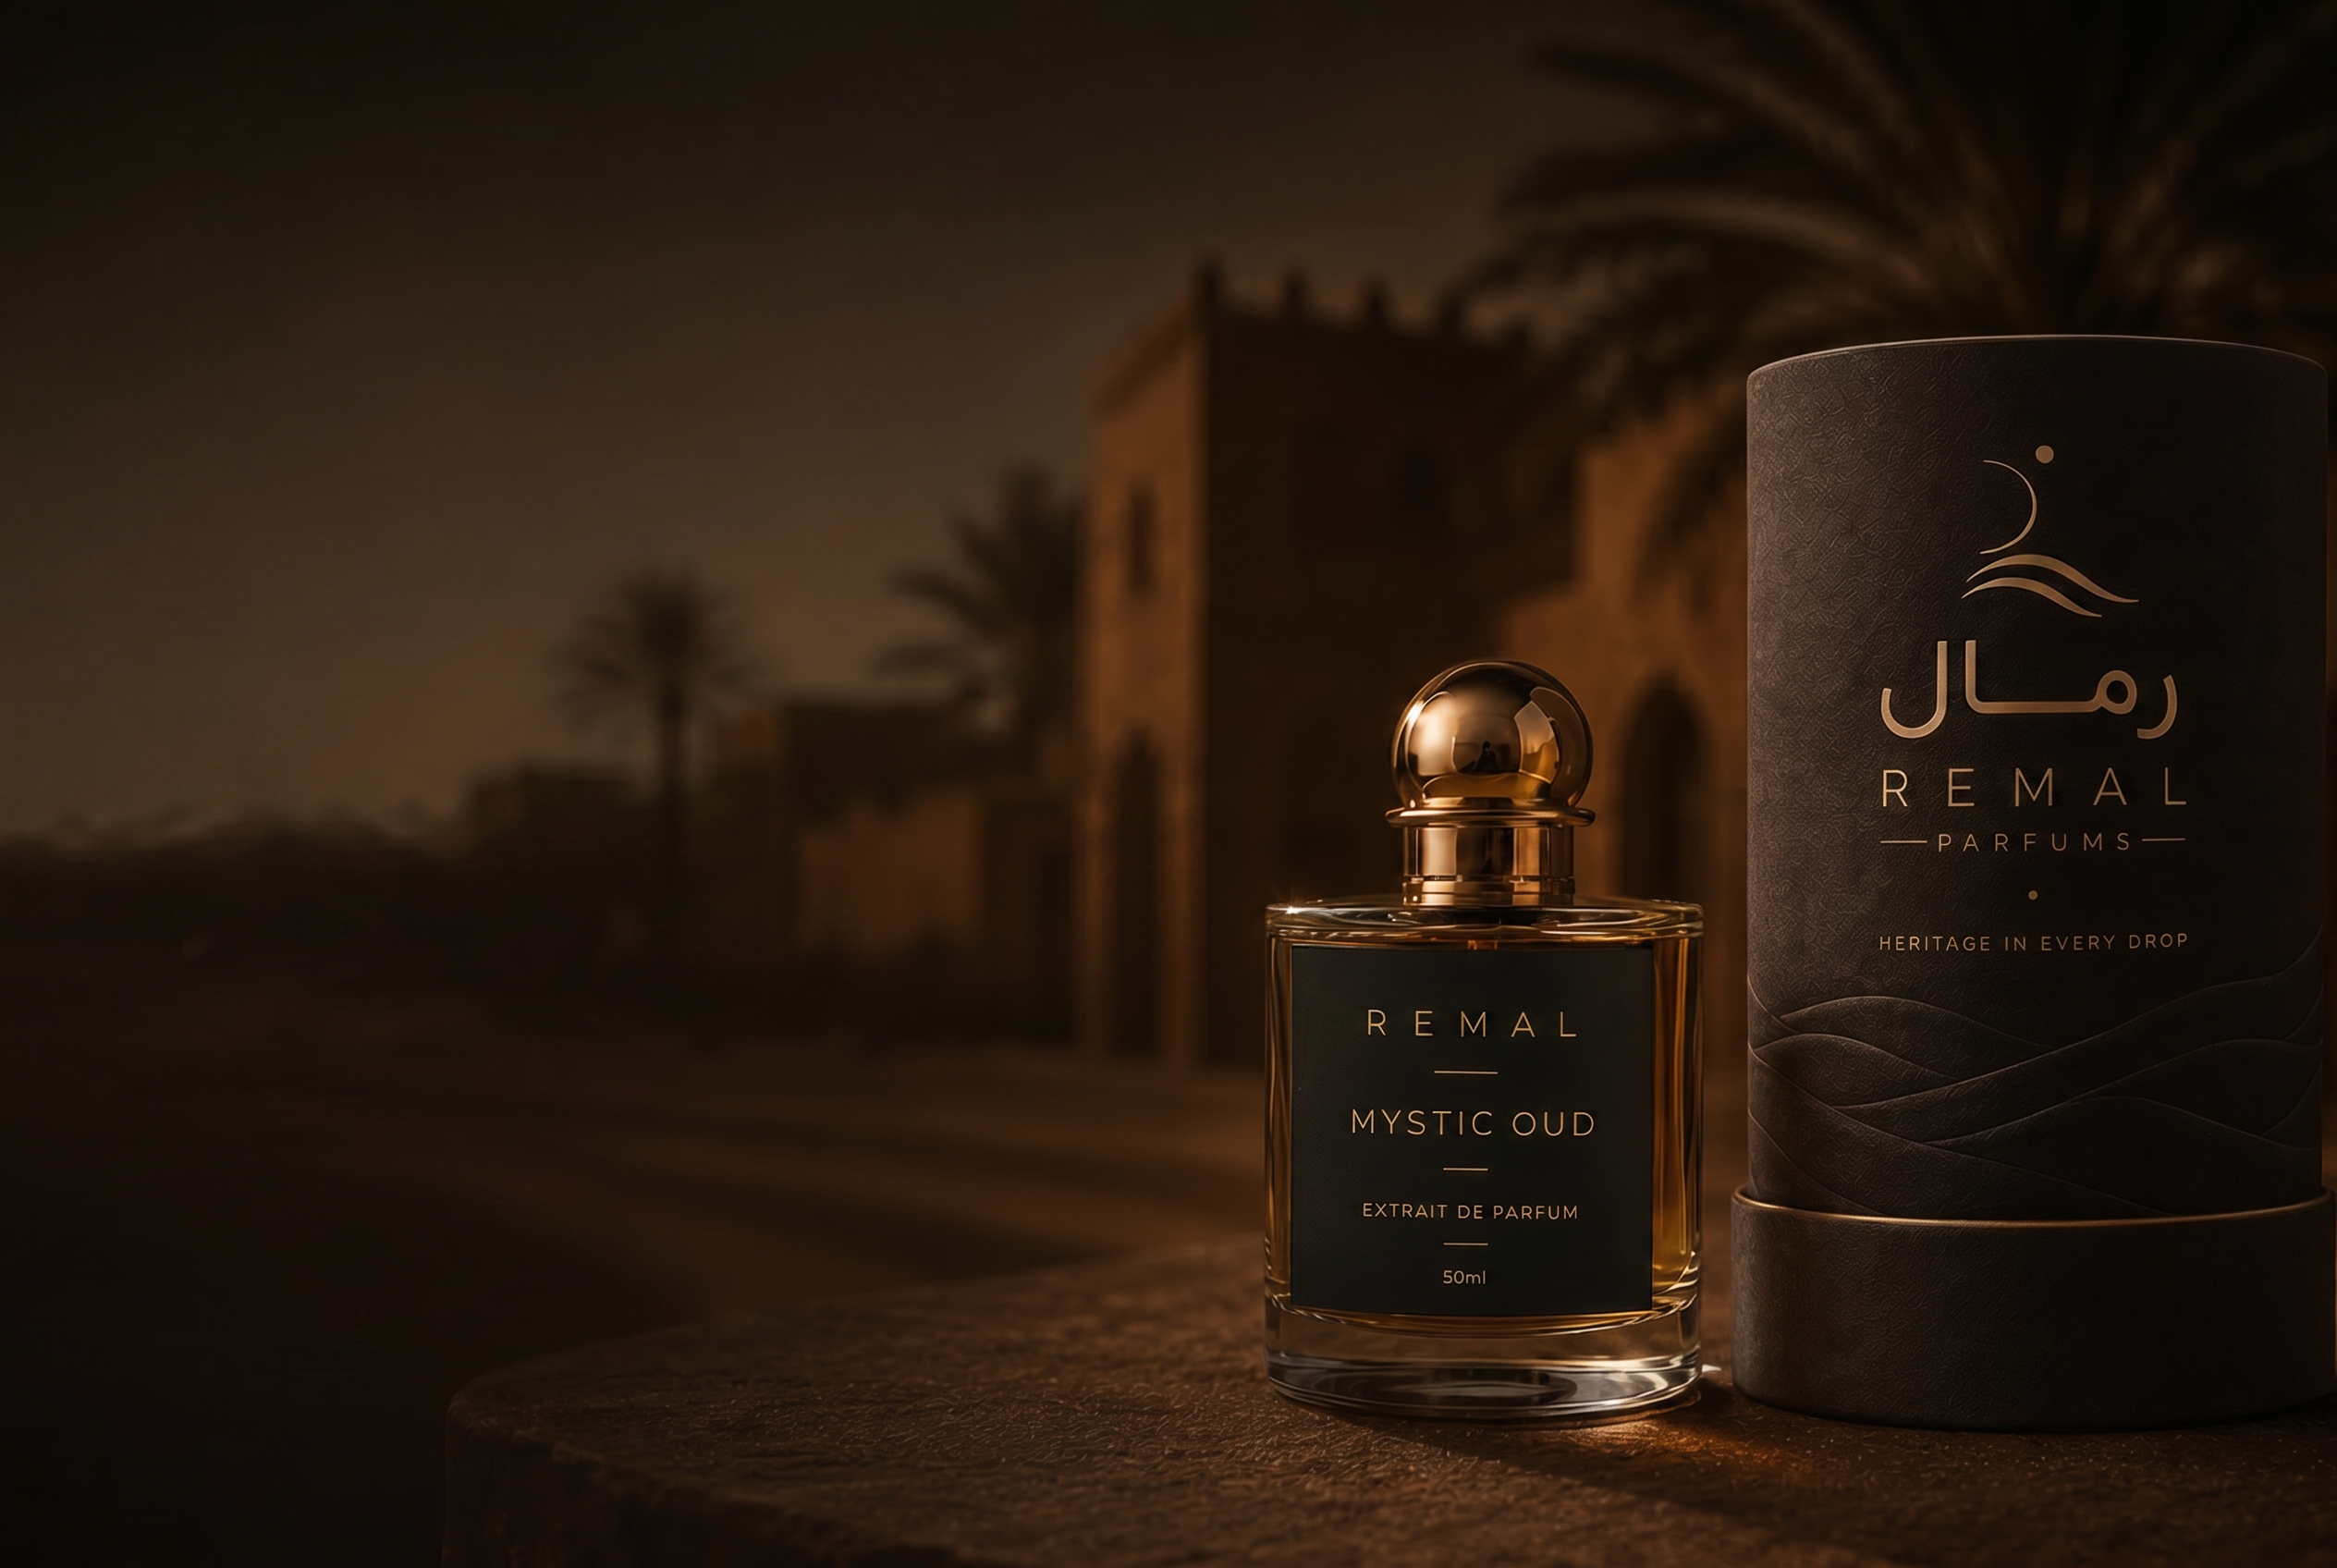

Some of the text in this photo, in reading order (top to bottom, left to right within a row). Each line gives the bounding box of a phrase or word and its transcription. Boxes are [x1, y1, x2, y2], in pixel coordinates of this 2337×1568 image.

[1880, 639, 2178, 740] رمال
[1881, 766, 2187, 808] REMAL
[1938, 832, 2131, 853] PARFUMS
[1878, 932, 2189, 952] HERITAGE IN EVERY DROP
[1366, 1008, 1578, 1038] REMAL
[1351, 1108, 1596, 1137] MYSTIC OUD
[1362, 1202, 1579, 1221] EXTRAIT DE PARFUM
[1441, 1268, 1487, 1286] 50ml
